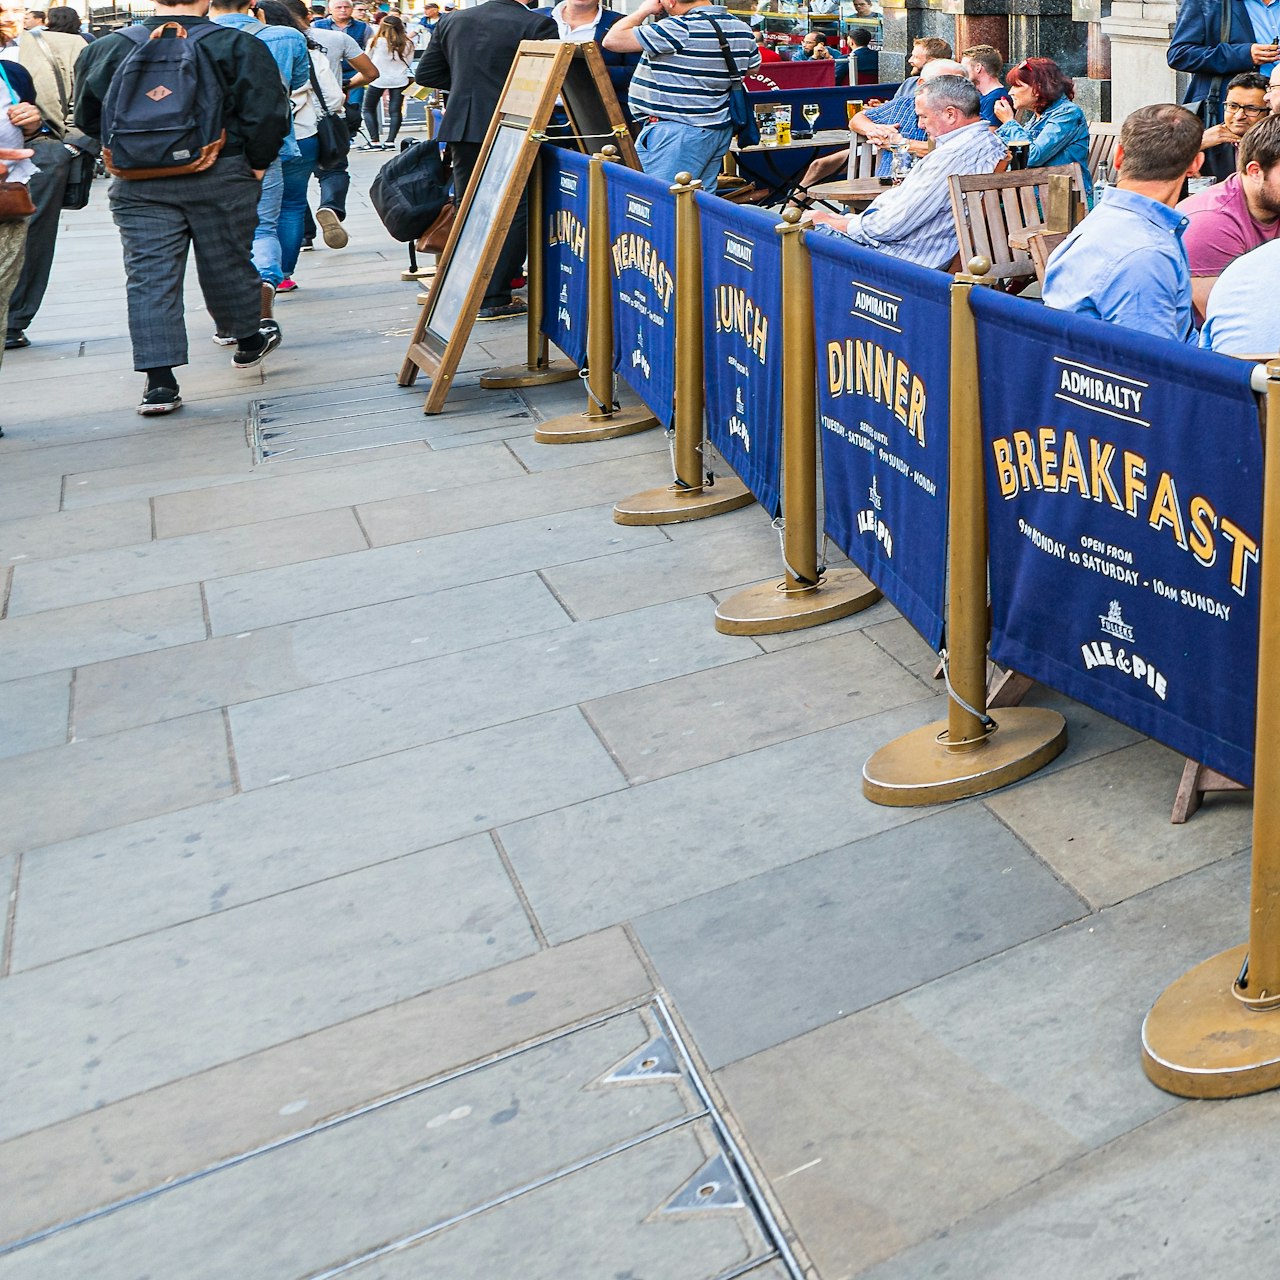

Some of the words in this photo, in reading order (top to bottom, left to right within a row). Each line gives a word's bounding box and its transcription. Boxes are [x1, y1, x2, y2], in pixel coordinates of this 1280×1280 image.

[549, 209, 586, 262] LUNCH
[854, 291, 898, 322] ADMIRALTY
[828, 339, 926, 448] DINNER
[1060, 369, 1142, 413] ADMIRALTY
[913, 470, 937, 497] MONDAY
[992, 427, 1259, 597] BREAKFAST
[1080, 536, 1105, 554] OPEN
[1106, 545, 1133, 565] FROM
[1069, 552, 1080, 564] to
[1082, 553, 1139, 587] SATURDAY
[1180, 590, 1231, 621] SUNDAY
